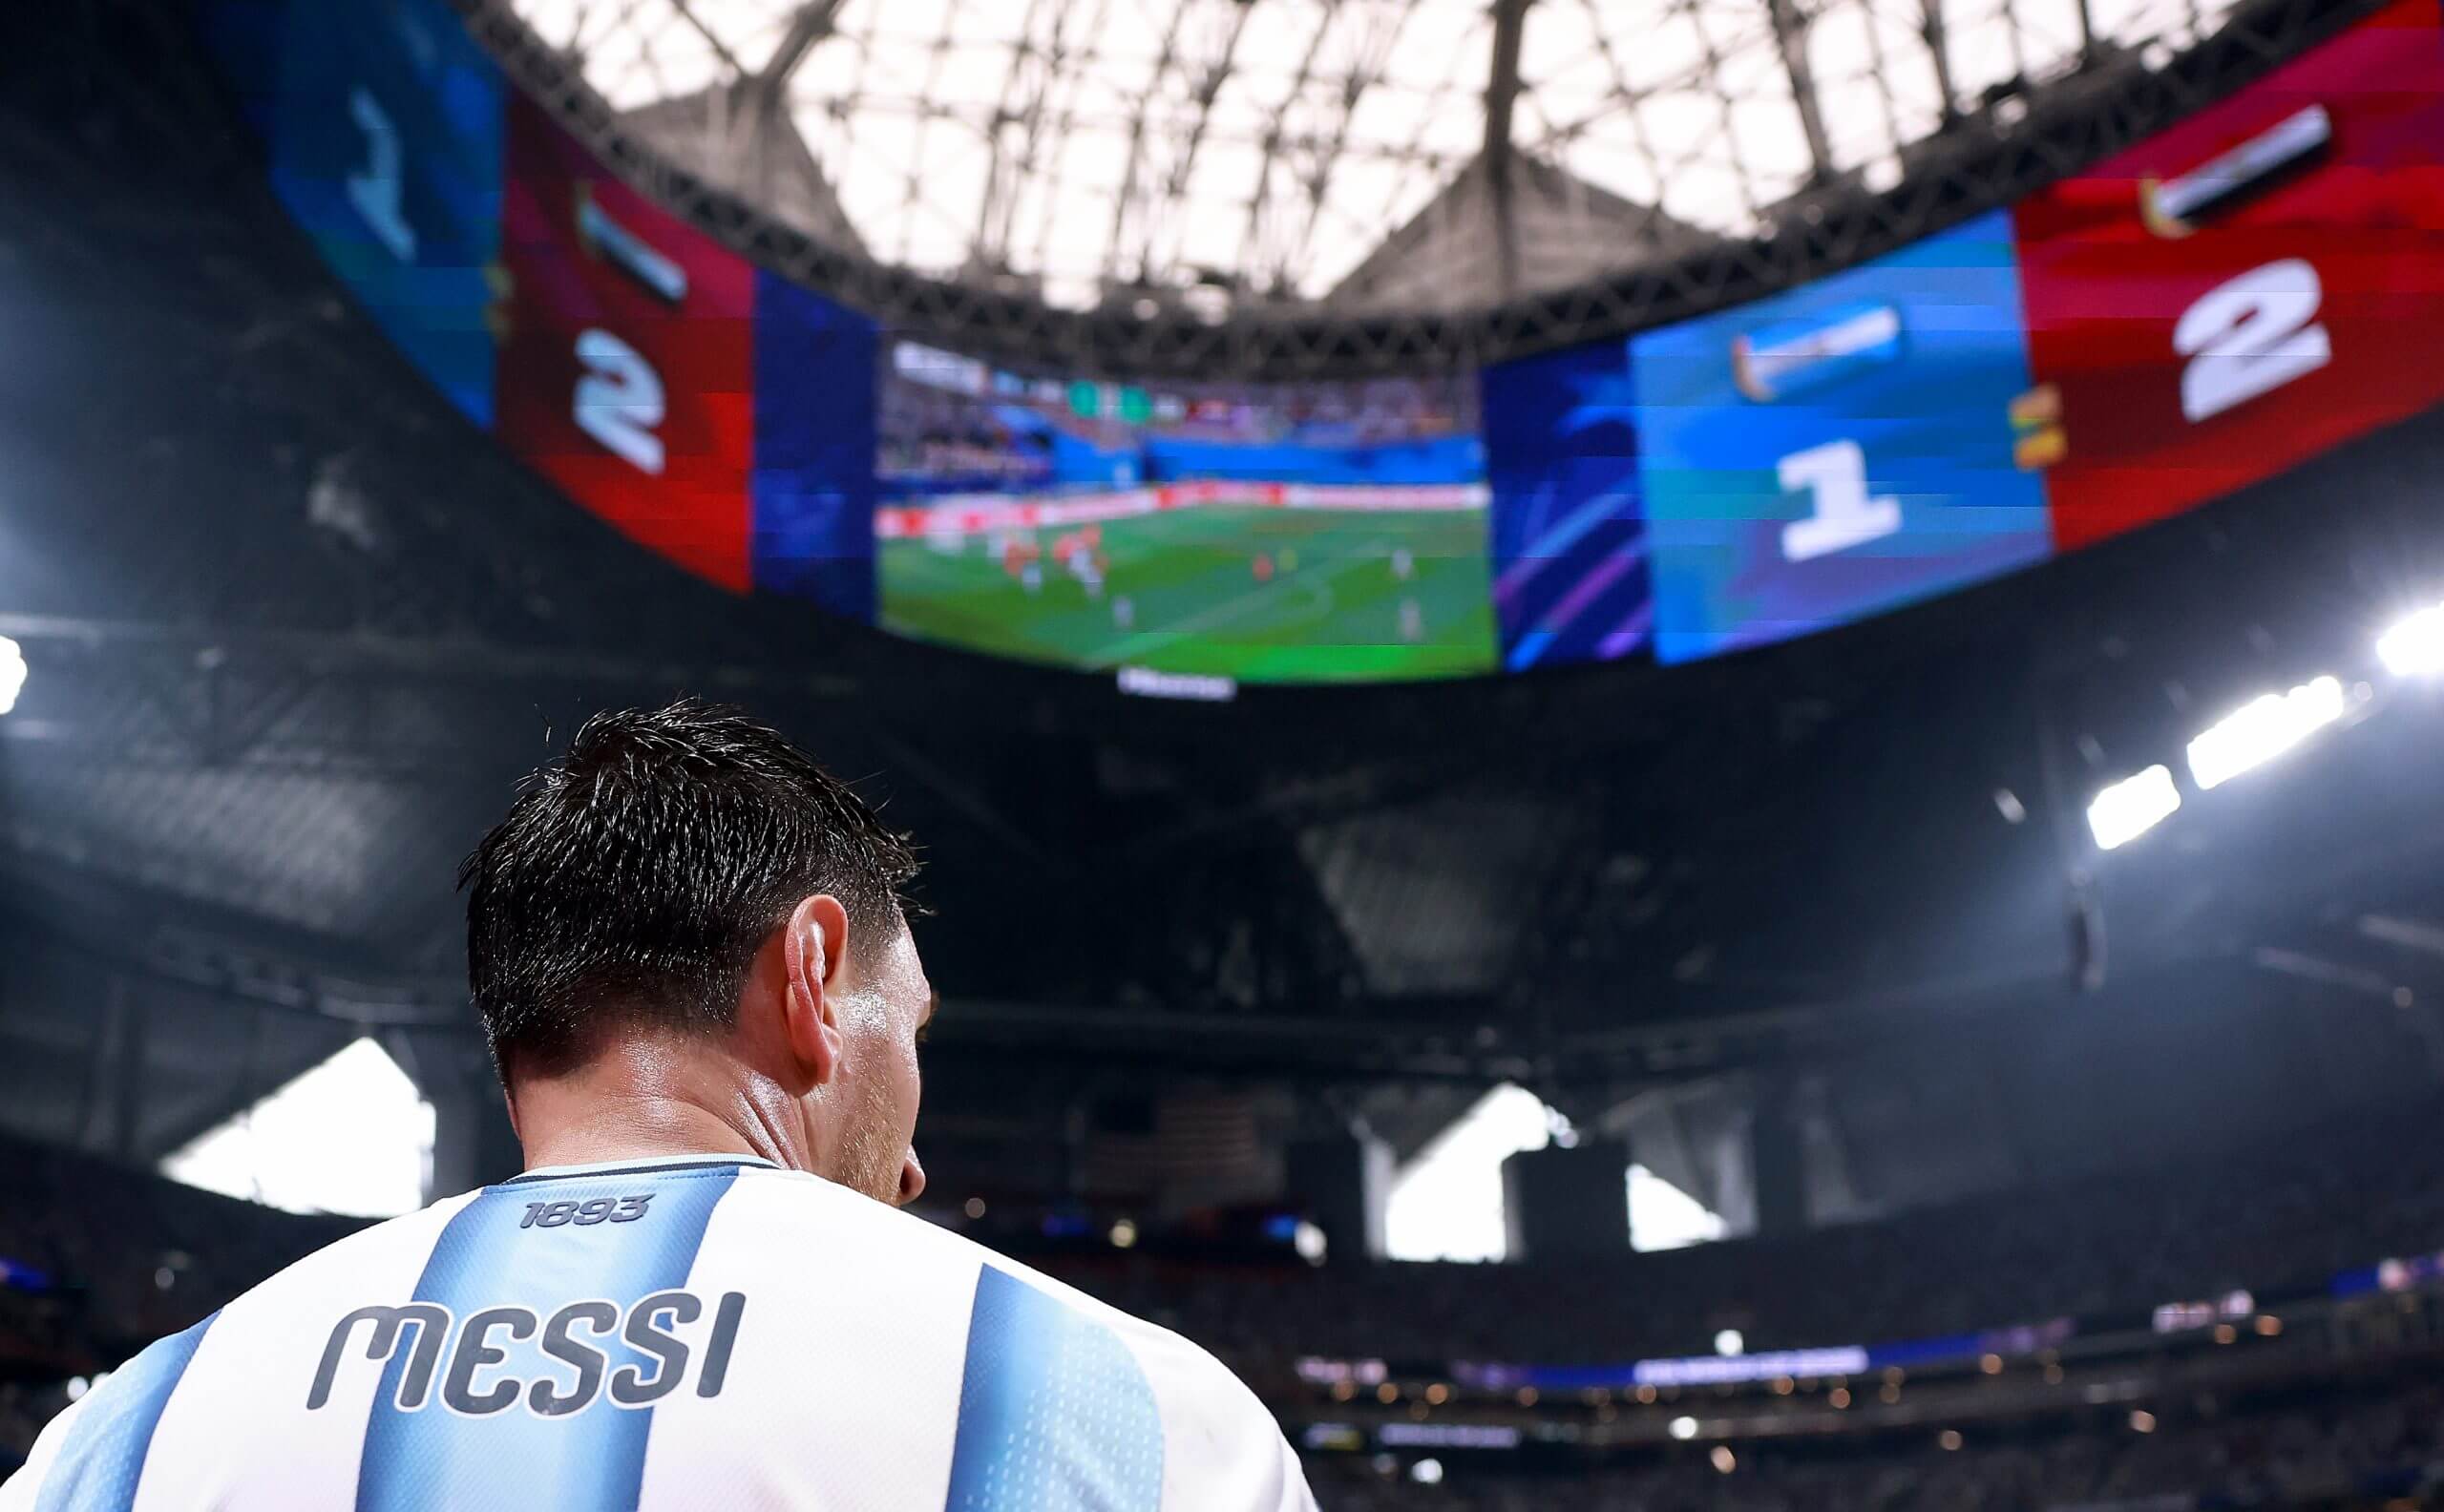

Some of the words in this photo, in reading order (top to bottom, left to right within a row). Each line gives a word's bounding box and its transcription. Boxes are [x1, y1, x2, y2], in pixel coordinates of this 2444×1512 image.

[575, 327, 666, 474] 2
[2173, 258, 2332, 422] 2
[1778, 438, 1903, 562] 1
[519, 1193, 656, 1228] 1893
[306, 1291, 748, 1417] MESSI
